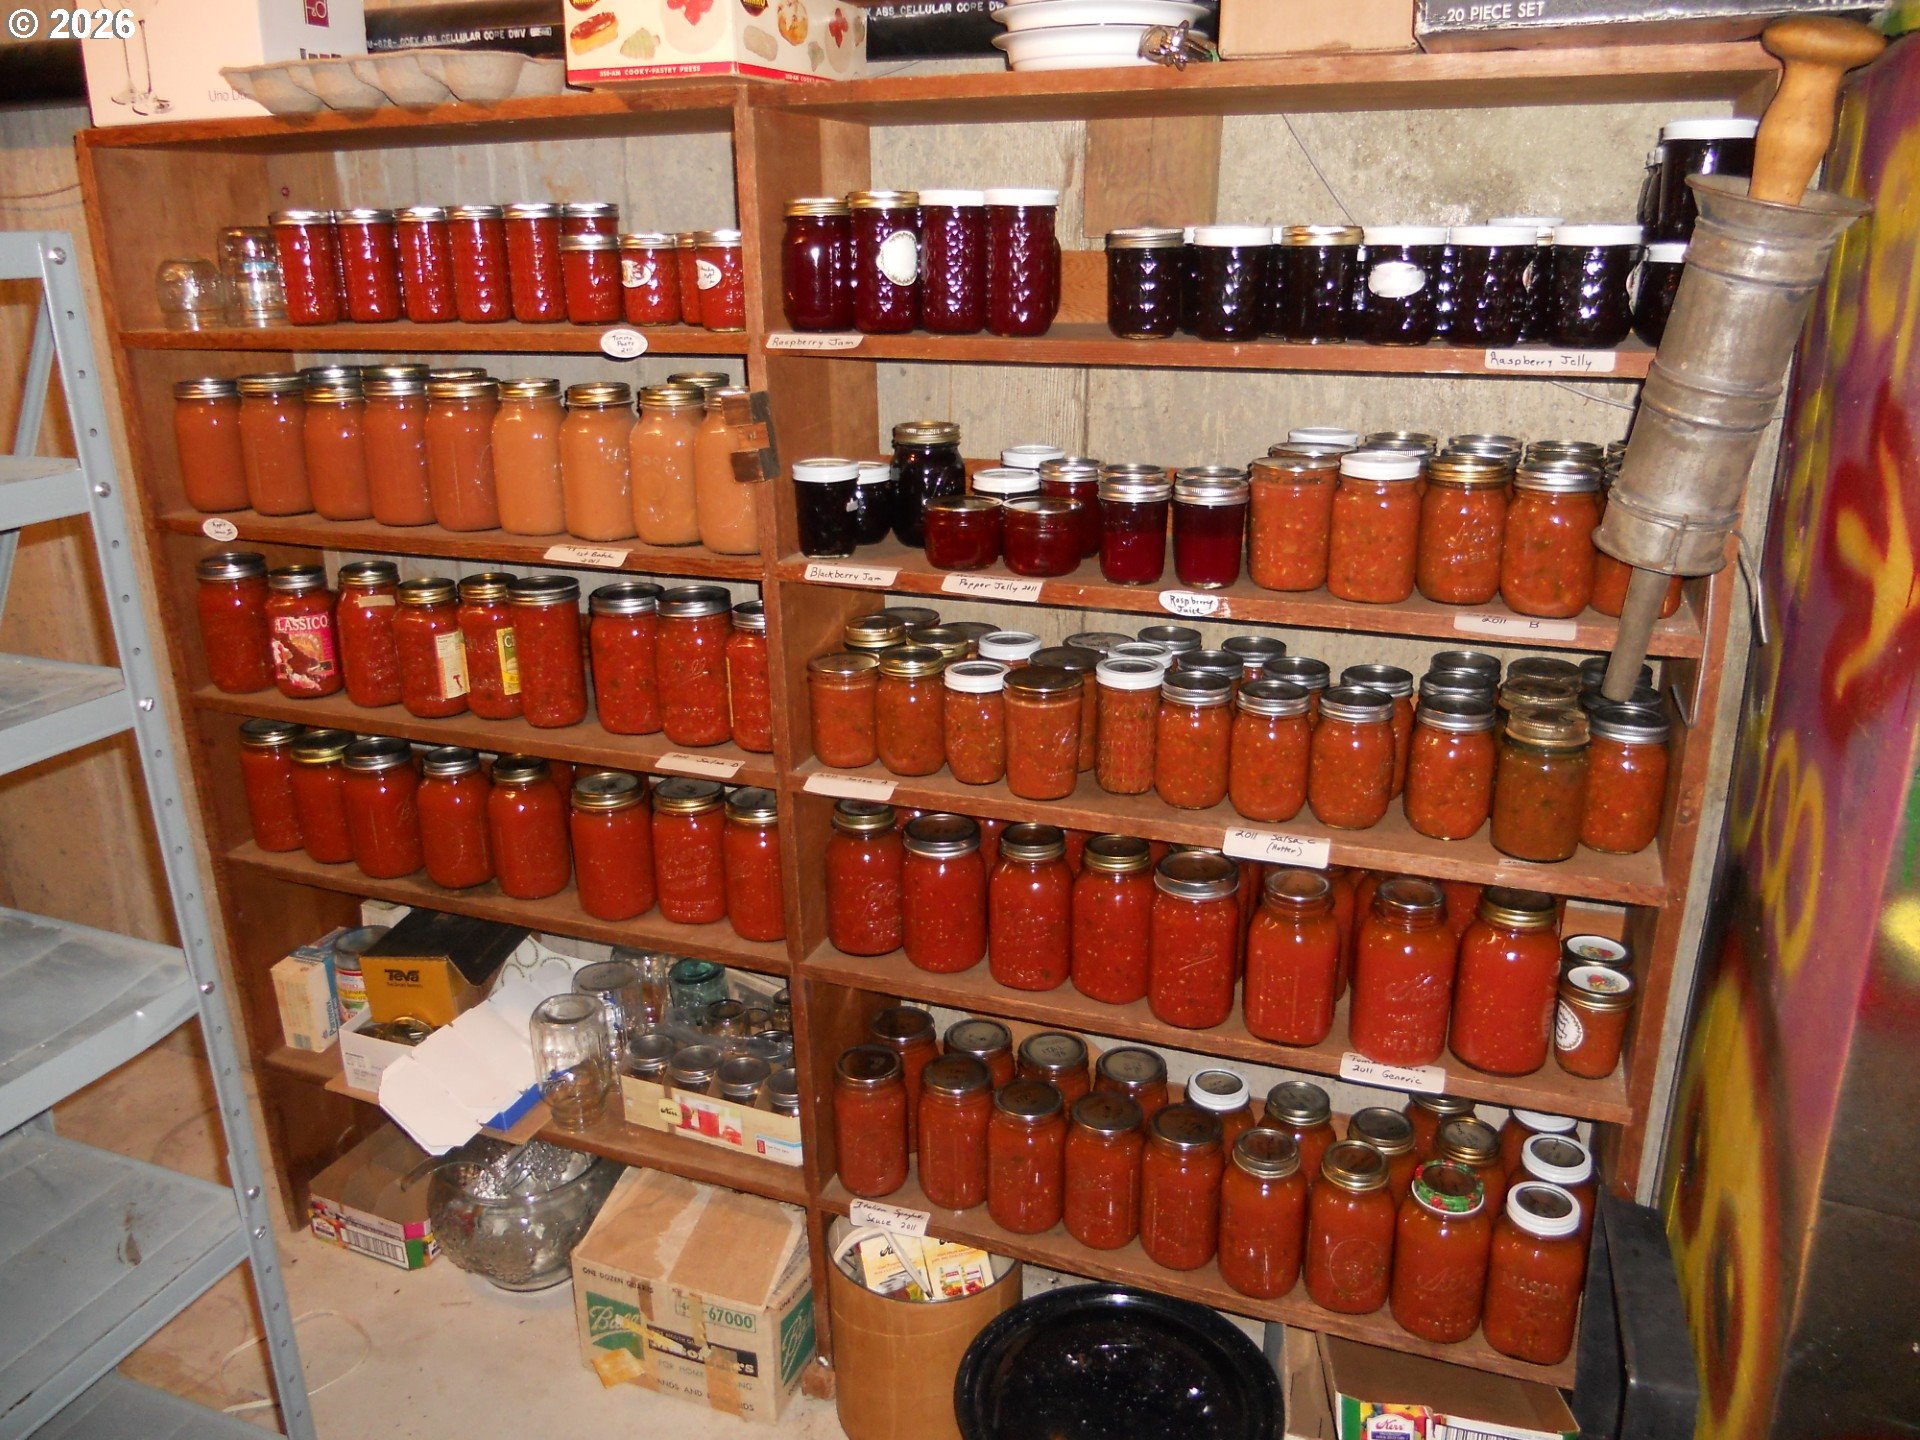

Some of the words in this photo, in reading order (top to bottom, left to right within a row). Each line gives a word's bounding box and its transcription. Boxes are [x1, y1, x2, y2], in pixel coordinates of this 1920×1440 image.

[900, 3, 953, 15] CELLULAR
[956, 2, 983, 13] CORE
[1447, 9, 1465, 22] 20
[1470, 5, 1511, 21] PIECE
[1517, 2, 1545, 18] SET
[441, 30, 481, 43] CELLULAR
[772, 336, 824, 349] Raspberry
[828, 338, 854, 347] Jam
[1490, 351, 1552, 368] Raspberry
[1560, 353, 1593, 372] Jelly
[810, 566, 859, 581] Blackberry
[862, 572, 882, 582] Jam
[1234, 829, 1258, 840] 2011
[1352, 1064, 1373, 1075] 2011
[1382, 1069, 1423, 1085] Generic
[901, 1220, 917, 1231] 2011
[600, 1273, 624, 1284] DOZEN
[1375, 1419, 1404, 1431] Kerr
